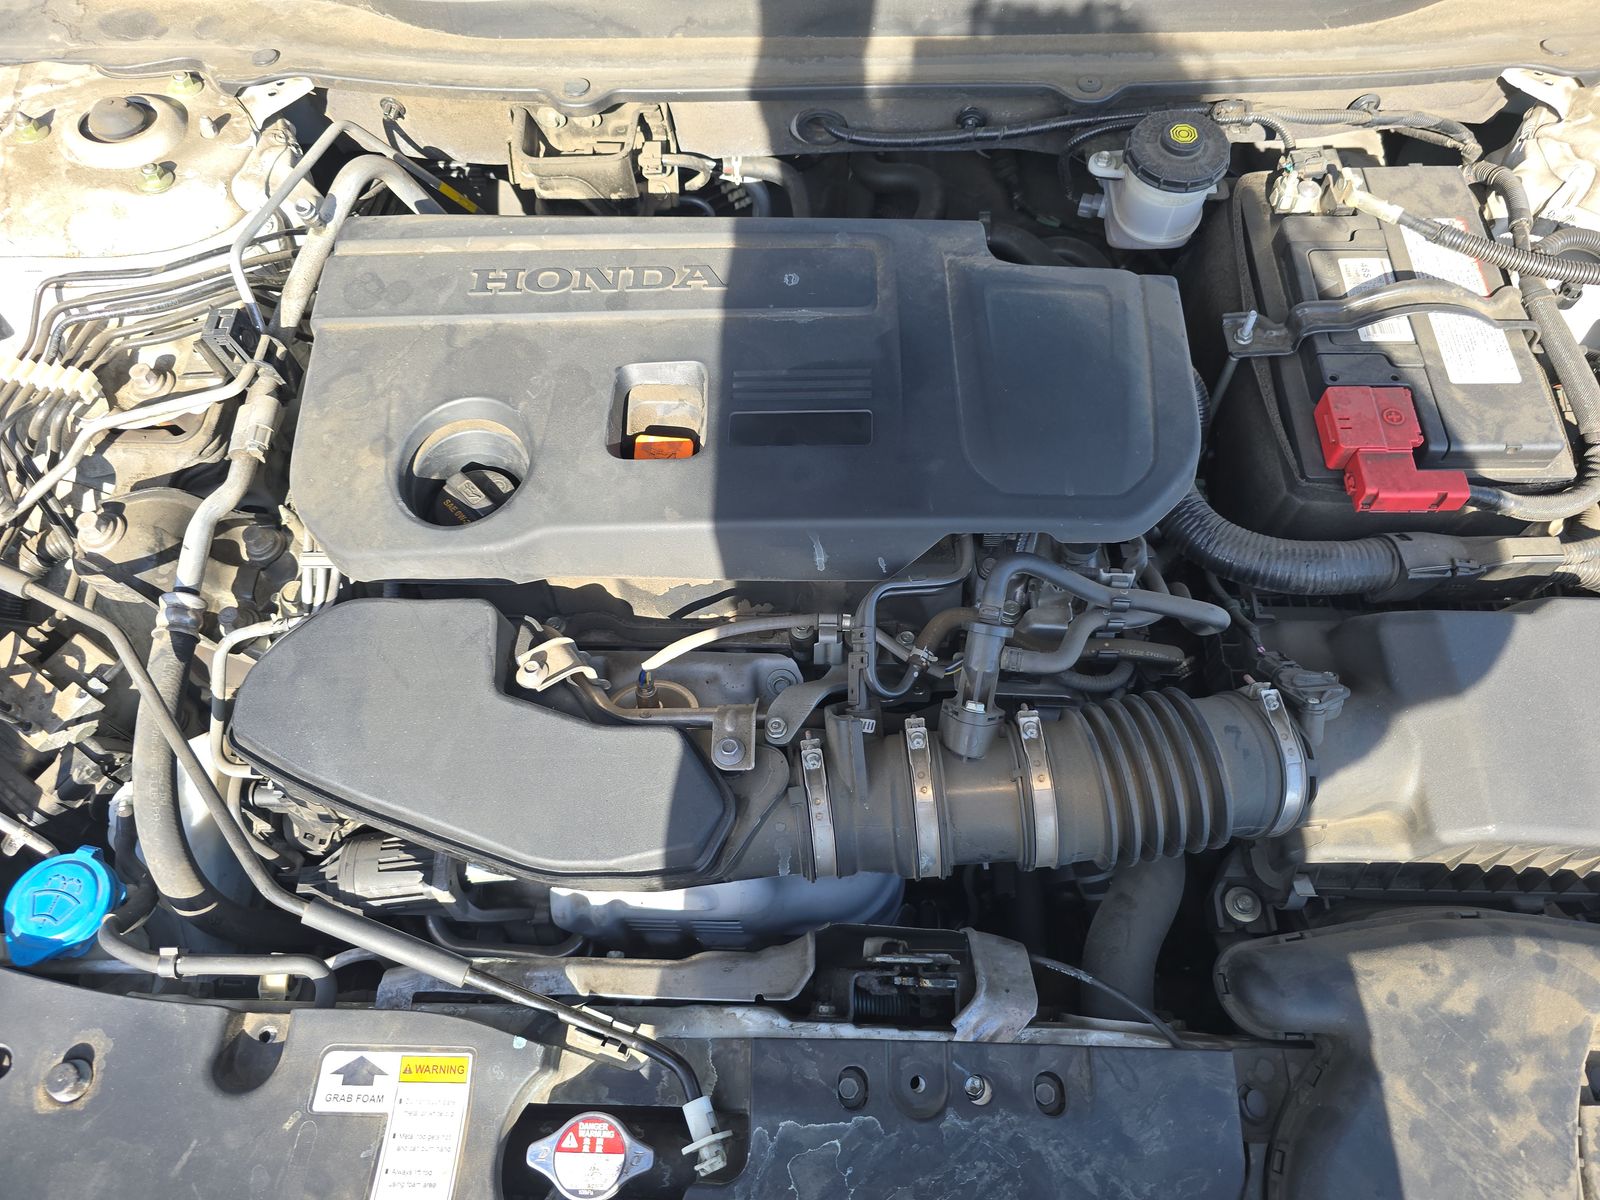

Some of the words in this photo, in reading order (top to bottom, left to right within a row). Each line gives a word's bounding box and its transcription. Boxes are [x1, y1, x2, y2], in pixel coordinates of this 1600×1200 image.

[468, 264, 728, 296] HONDA
[443, 499, 458, 513] SAE
[415, 1064, 466, 1075] WARNING
[325, 1093, 353, 1103] GRAB
[356, 1094, 384, 1103] FOAM
[579, 1122, 609, 1130] DANGER
